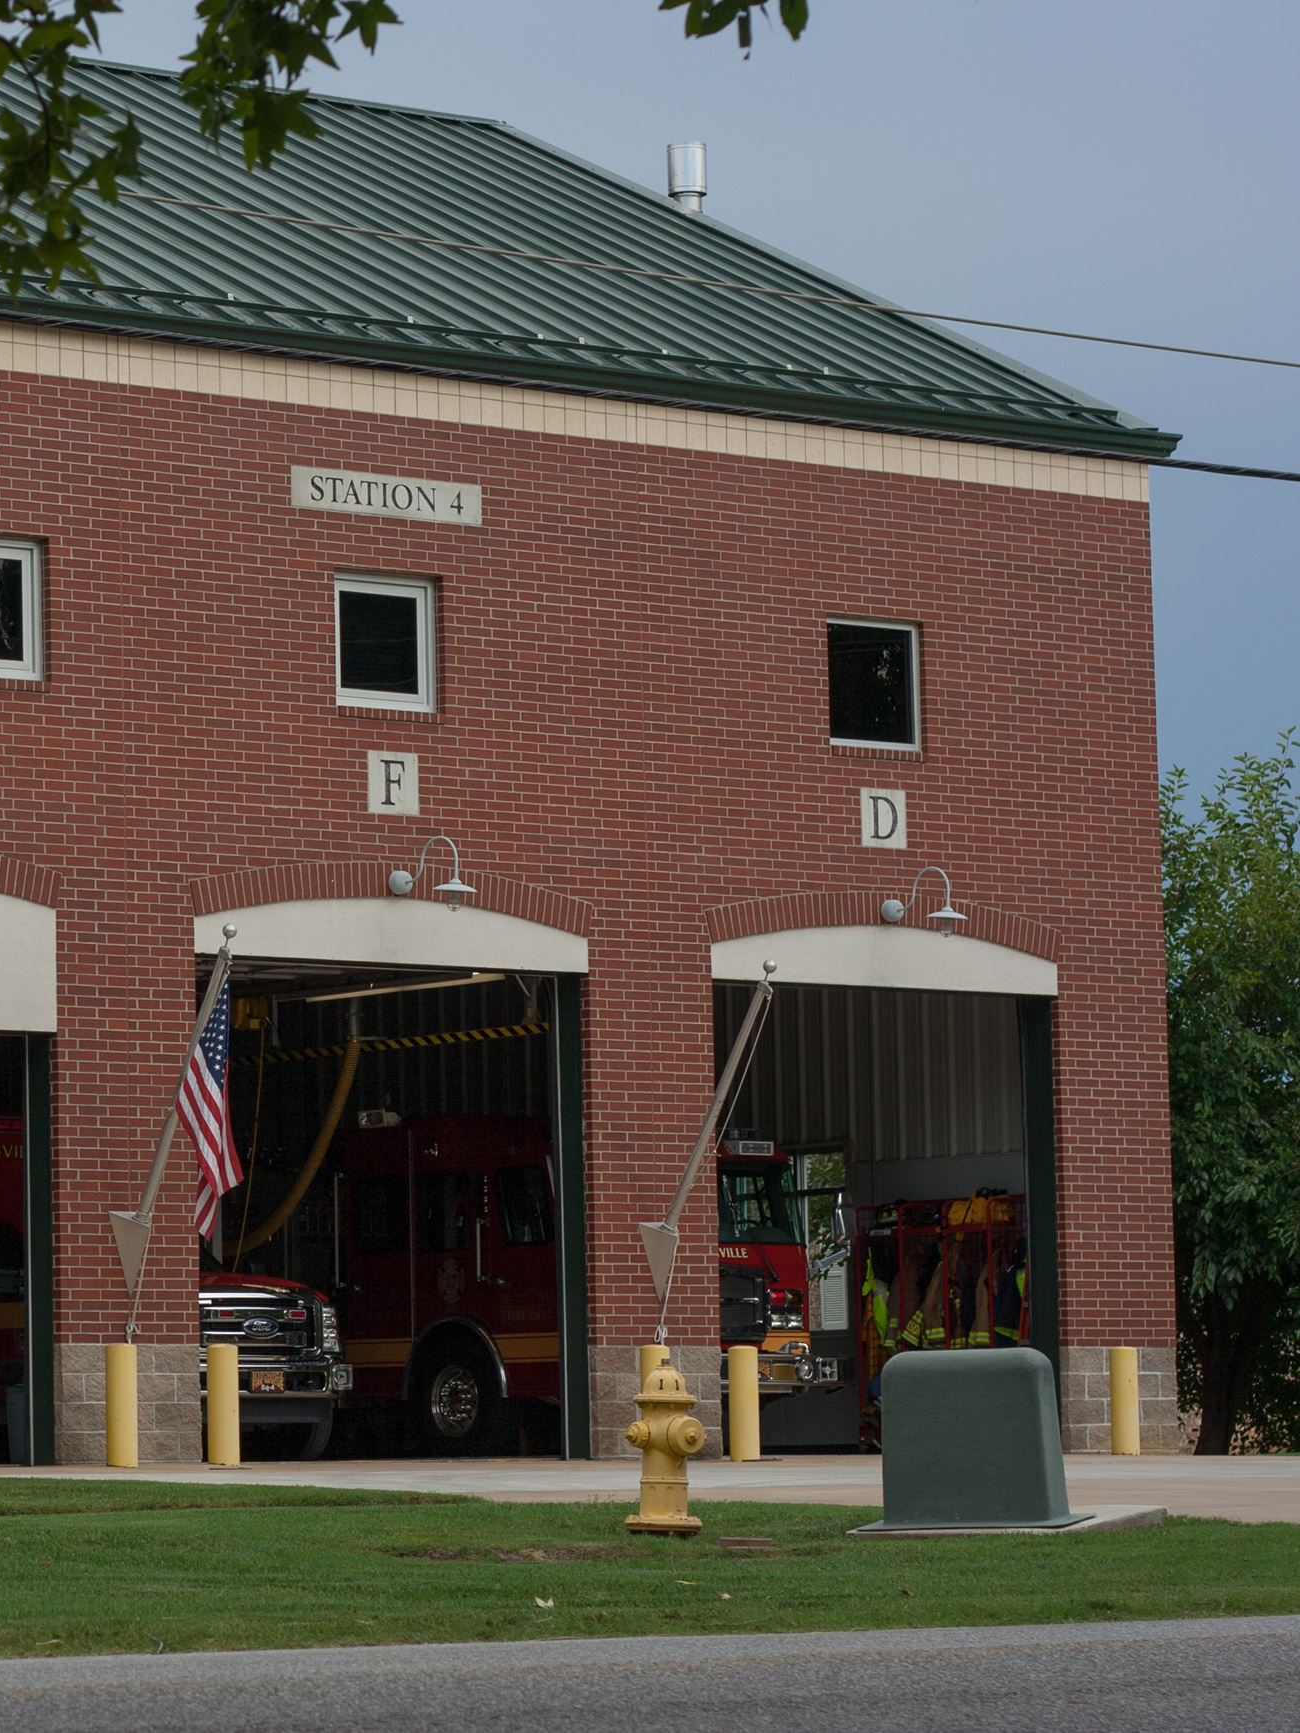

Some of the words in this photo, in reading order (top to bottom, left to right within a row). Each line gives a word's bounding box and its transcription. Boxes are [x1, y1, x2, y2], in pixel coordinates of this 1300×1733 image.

[309, 474, 437, 513] STATION
[450, 490, 464, 516] 4
[379, 759, 406, 806] F
[868, 795, 899, 840] D
[718, 1247, 748, 1258] VILLE
[252, 1320, 272, 1332] Ford
